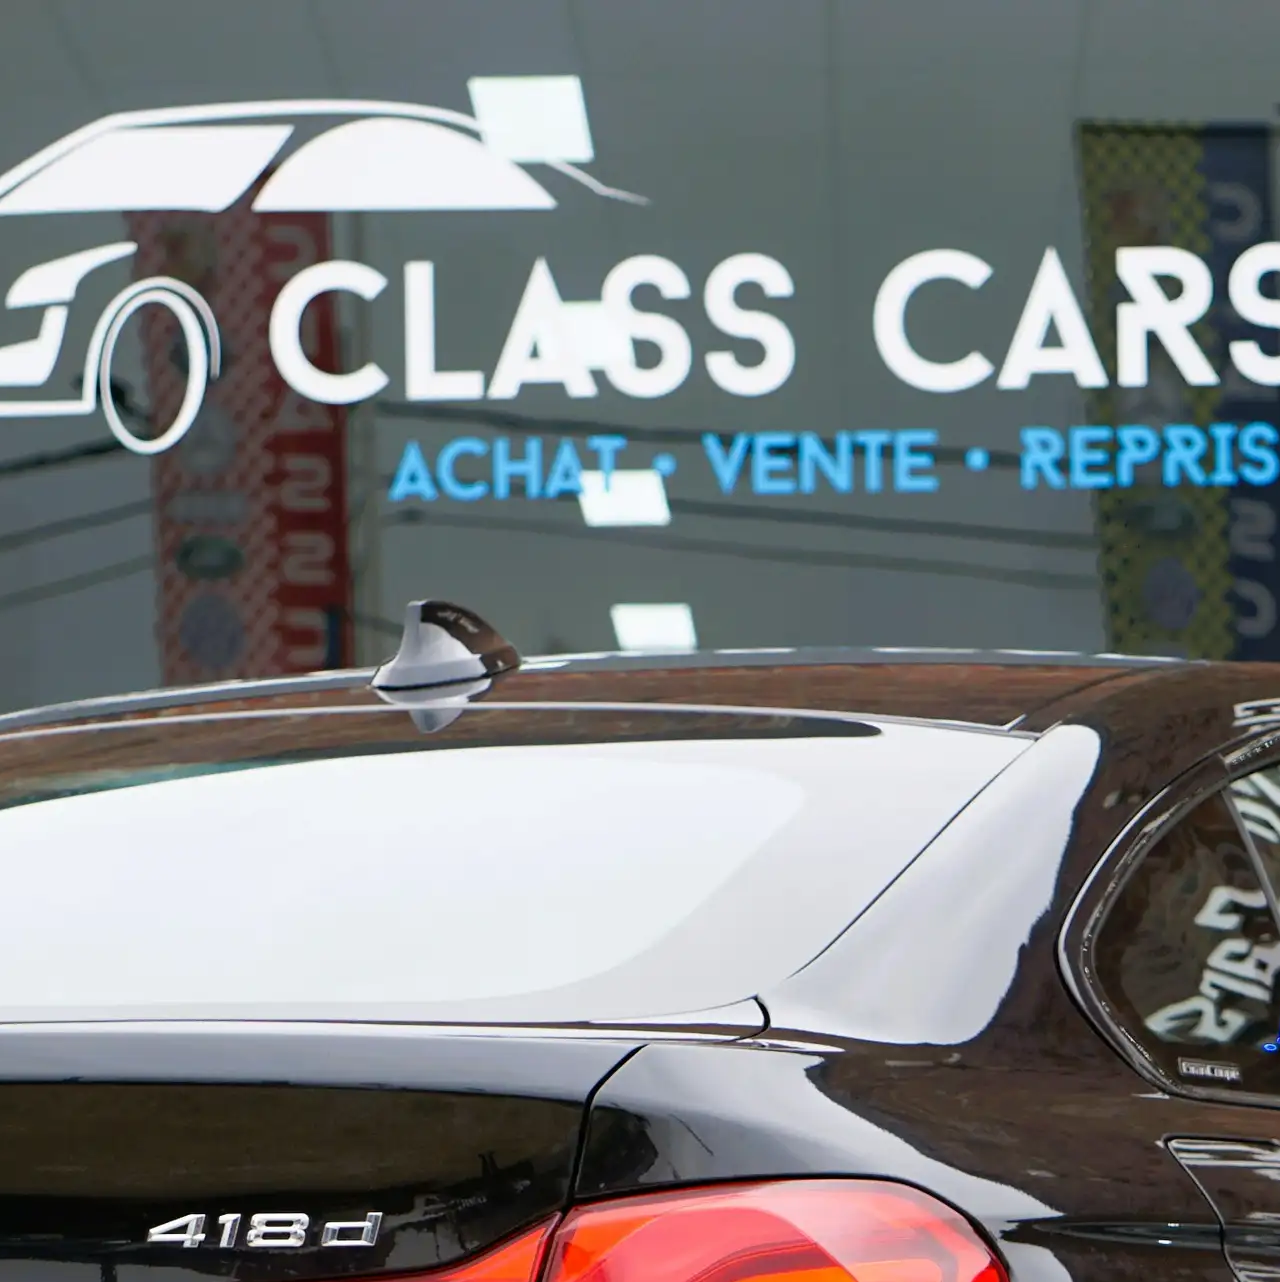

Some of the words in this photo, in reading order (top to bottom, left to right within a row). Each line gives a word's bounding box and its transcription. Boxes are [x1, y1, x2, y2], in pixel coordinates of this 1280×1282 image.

[269, 252, 797, 404] CLASS
[388, 434, 627, 501] ACHAT
[702, 430, 940, 494] VENTE
[146, 1211, 383, 1248] 418d
